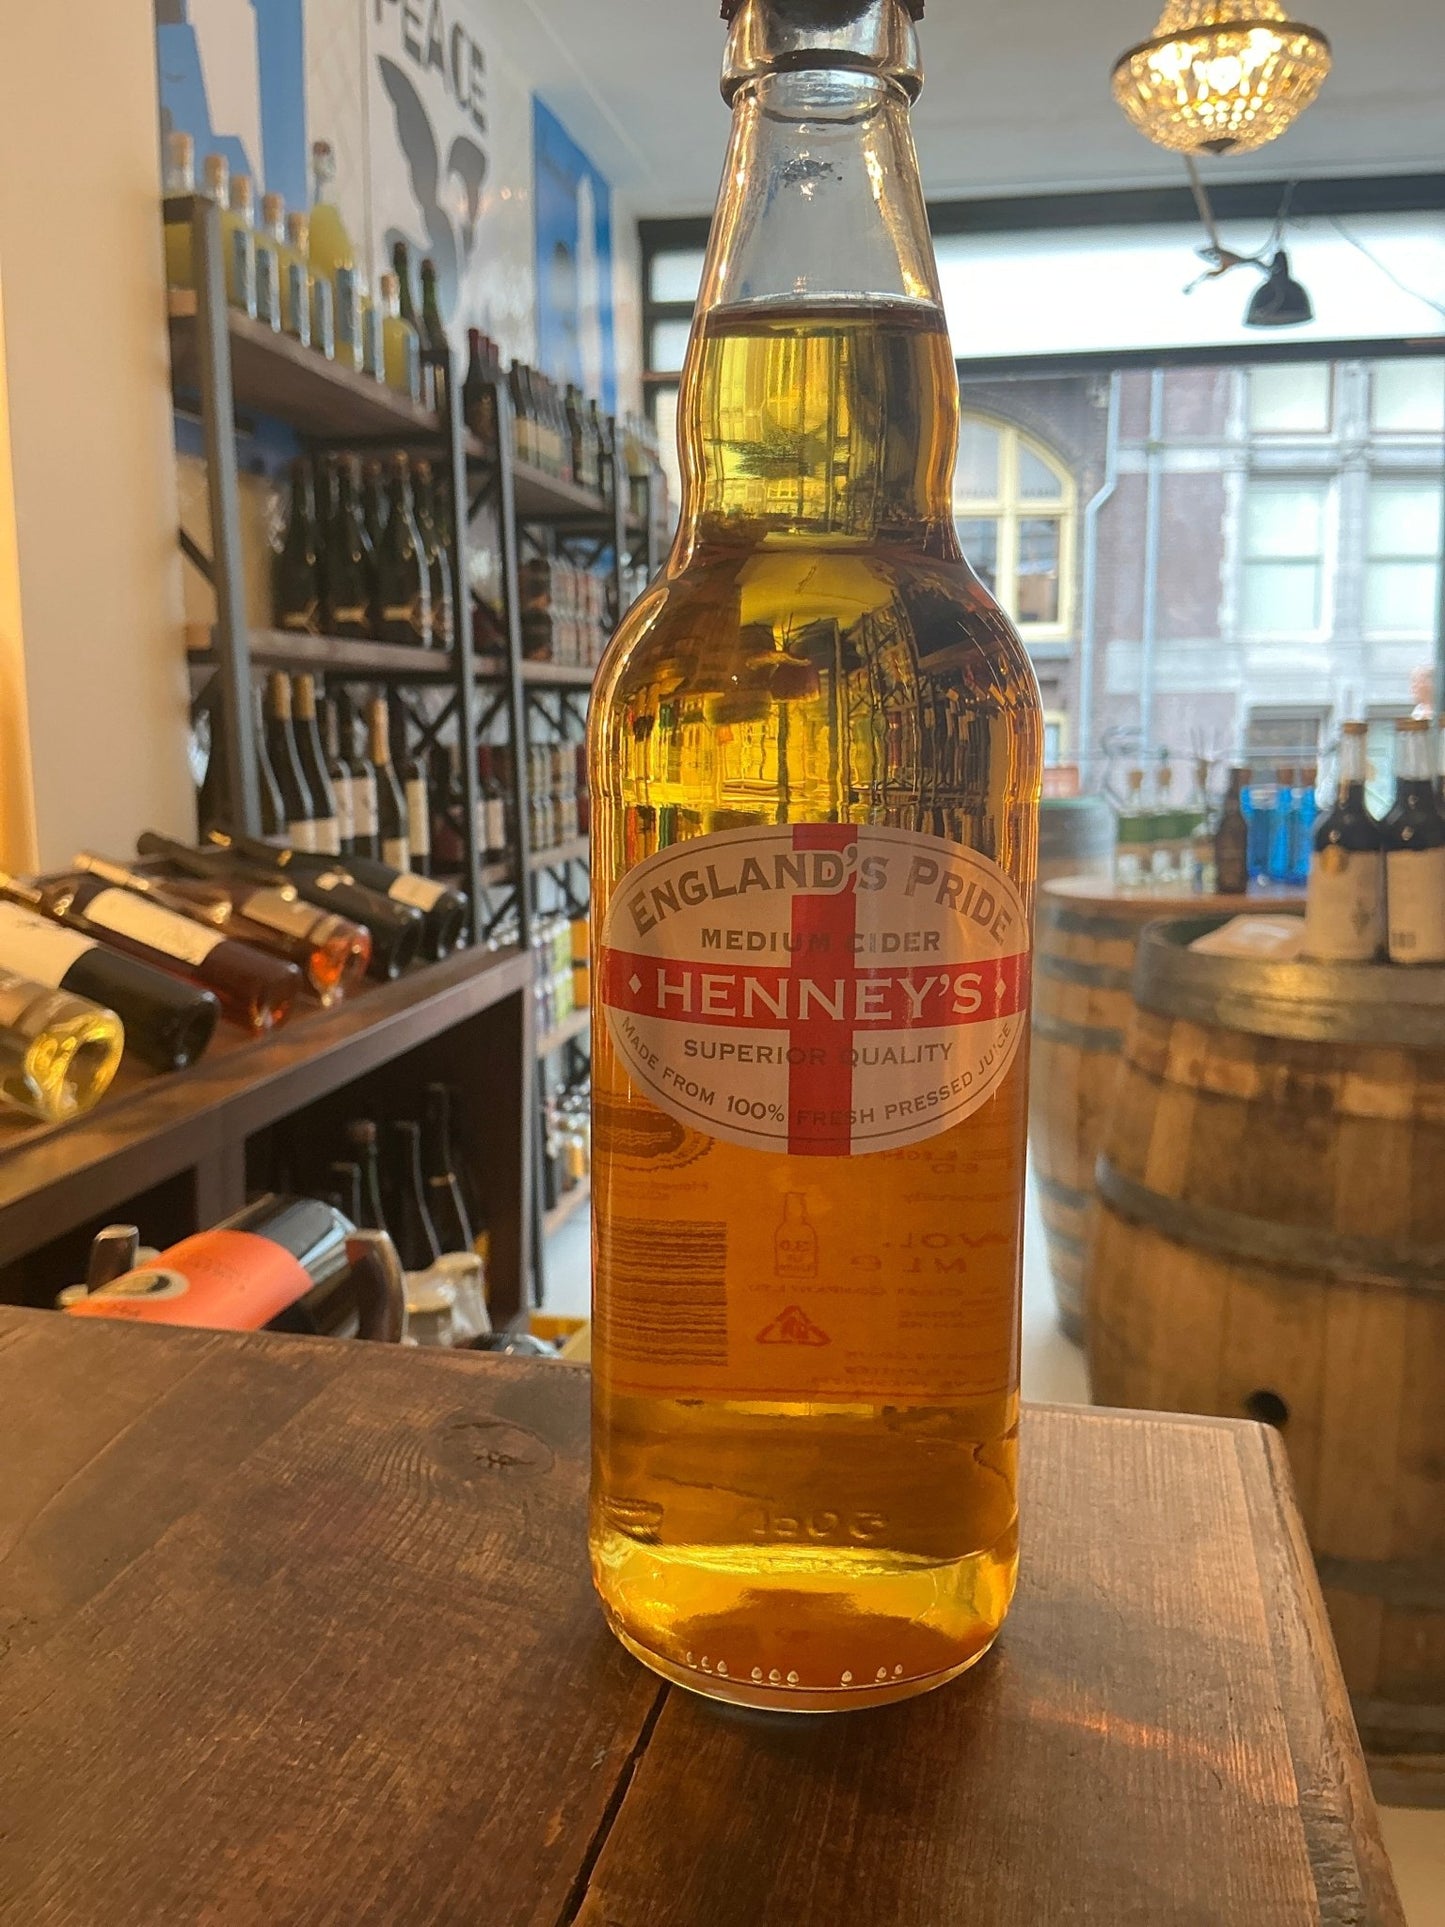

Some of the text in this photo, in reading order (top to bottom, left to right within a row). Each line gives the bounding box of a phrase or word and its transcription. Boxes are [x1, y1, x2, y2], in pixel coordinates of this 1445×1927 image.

[627, 846, 1013, 946] ENGLAND'S PRIDE
[701, 928, 941, 953] MEDIUM CIDER
[656, 968, 983, 1020] HENNEY'S
[622, 1016, 1012, 1126] MADE FROM 100% FRESH PRESSED JUICE
[684, 1039, 953, 1068] SUPERIOR QUALITY
